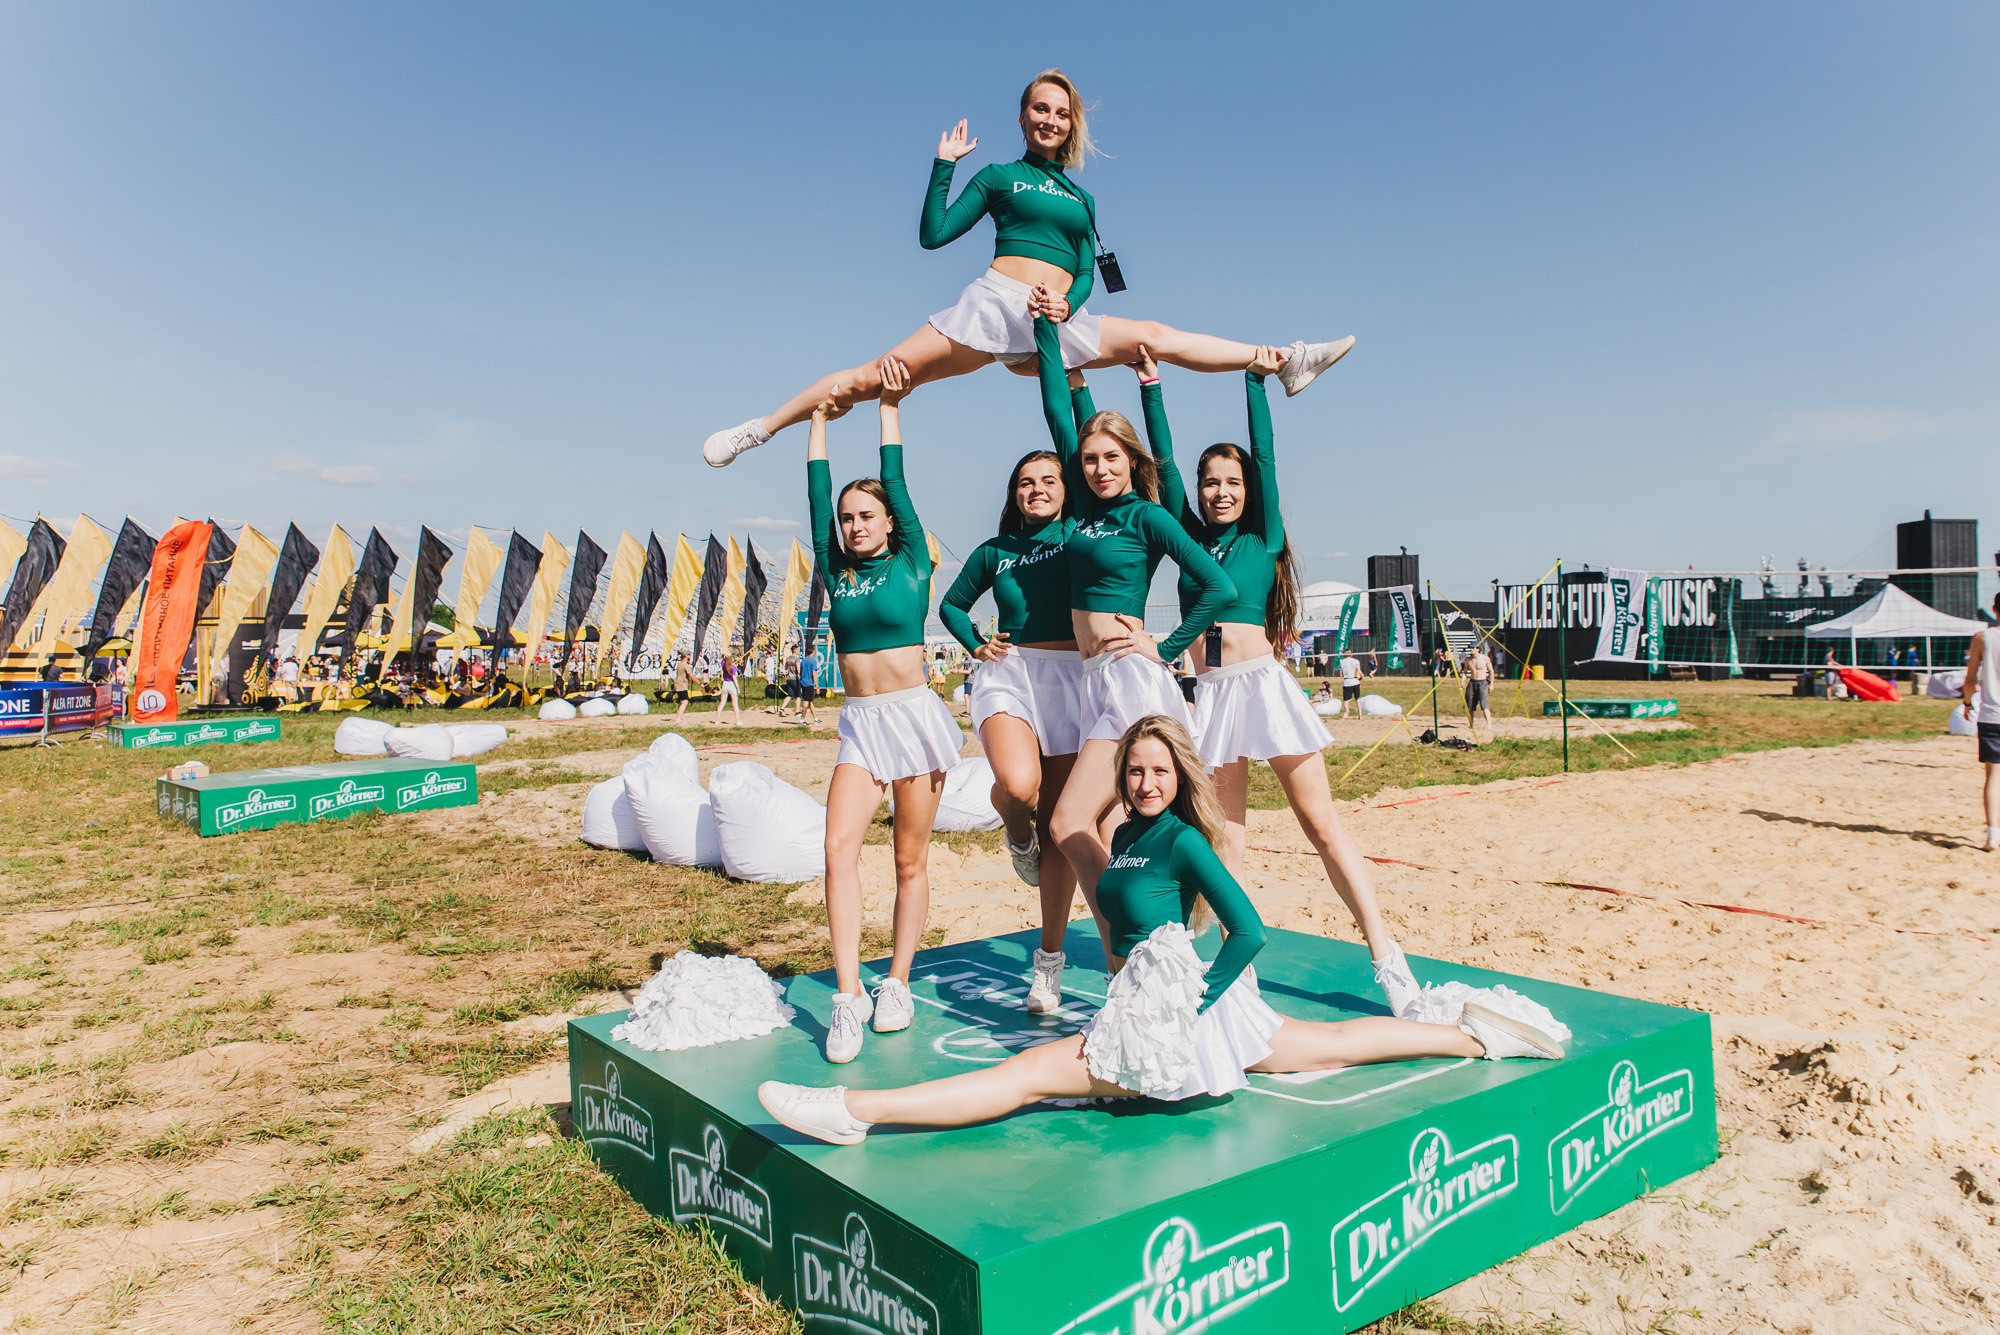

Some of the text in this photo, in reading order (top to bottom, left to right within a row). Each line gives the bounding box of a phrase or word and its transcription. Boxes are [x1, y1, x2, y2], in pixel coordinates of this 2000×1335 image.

[1013, 181, 1036, 194] Dr.
[163, 540, 183, 589] ПИТАНИЕ
[995, 558, 1017, 576] Dr.
[1394, 595, 1406, 610] Dr.
[1497, 583, 1566, 629] MILLER
[1612, 584, 1628, 653] Dr. Körner
[1649, 598, 1658, 655] Dr. Körner
[52, 697, 66, 711] ALFA
[67, 696, 75, 709] FIT
[76, 695, 92, 707] ZONE
[222, 798, 292, 824] Dr. Körner
[315, 788, 380, 813] Dr. Körner
[402, 779, 462, 804] Dr. Körner
[1111, 854, 1150, 869] Körner
[584, 1095, 648, 1145] Dr. Körner
[1561, 1087, 1684, 1191] Dr. Körner
[676, 1162, 763, 1230] Dr. Körner
[1348, 1154, 1506, 1283] Dr. Körner
[803, 1251, 929, 1335] Dr. Körner
[1133, 1245, 1274, 1335] Körner
